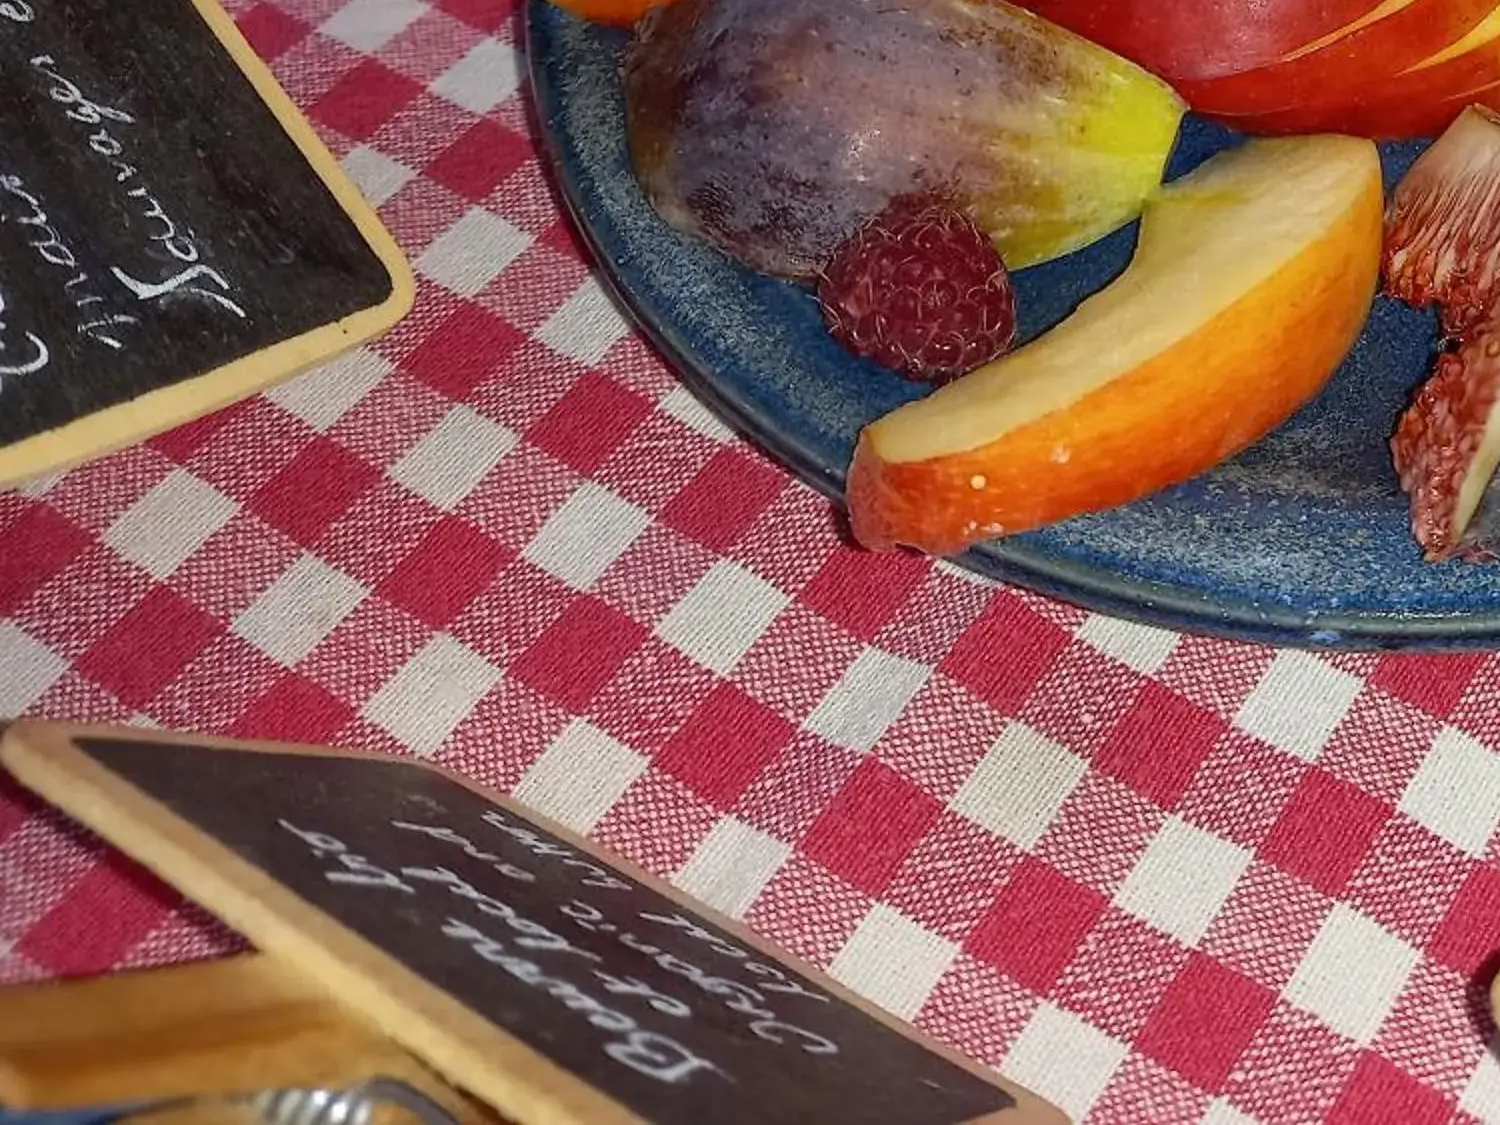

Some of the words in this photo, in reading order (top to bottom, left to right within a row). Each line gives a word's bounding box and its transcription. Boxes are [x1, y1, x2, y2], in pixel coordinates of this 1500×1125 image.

[30, 55, 246, 318] Sauvages
[276, 818, 414, 893] bio
[391, 820, 534, 882] and
[401, 866, 602, 962] local
[440, 917, 736, 1084] Beurre
[560, 901, 839, 1054] Organic
[595, 971, 690, 1019] et
